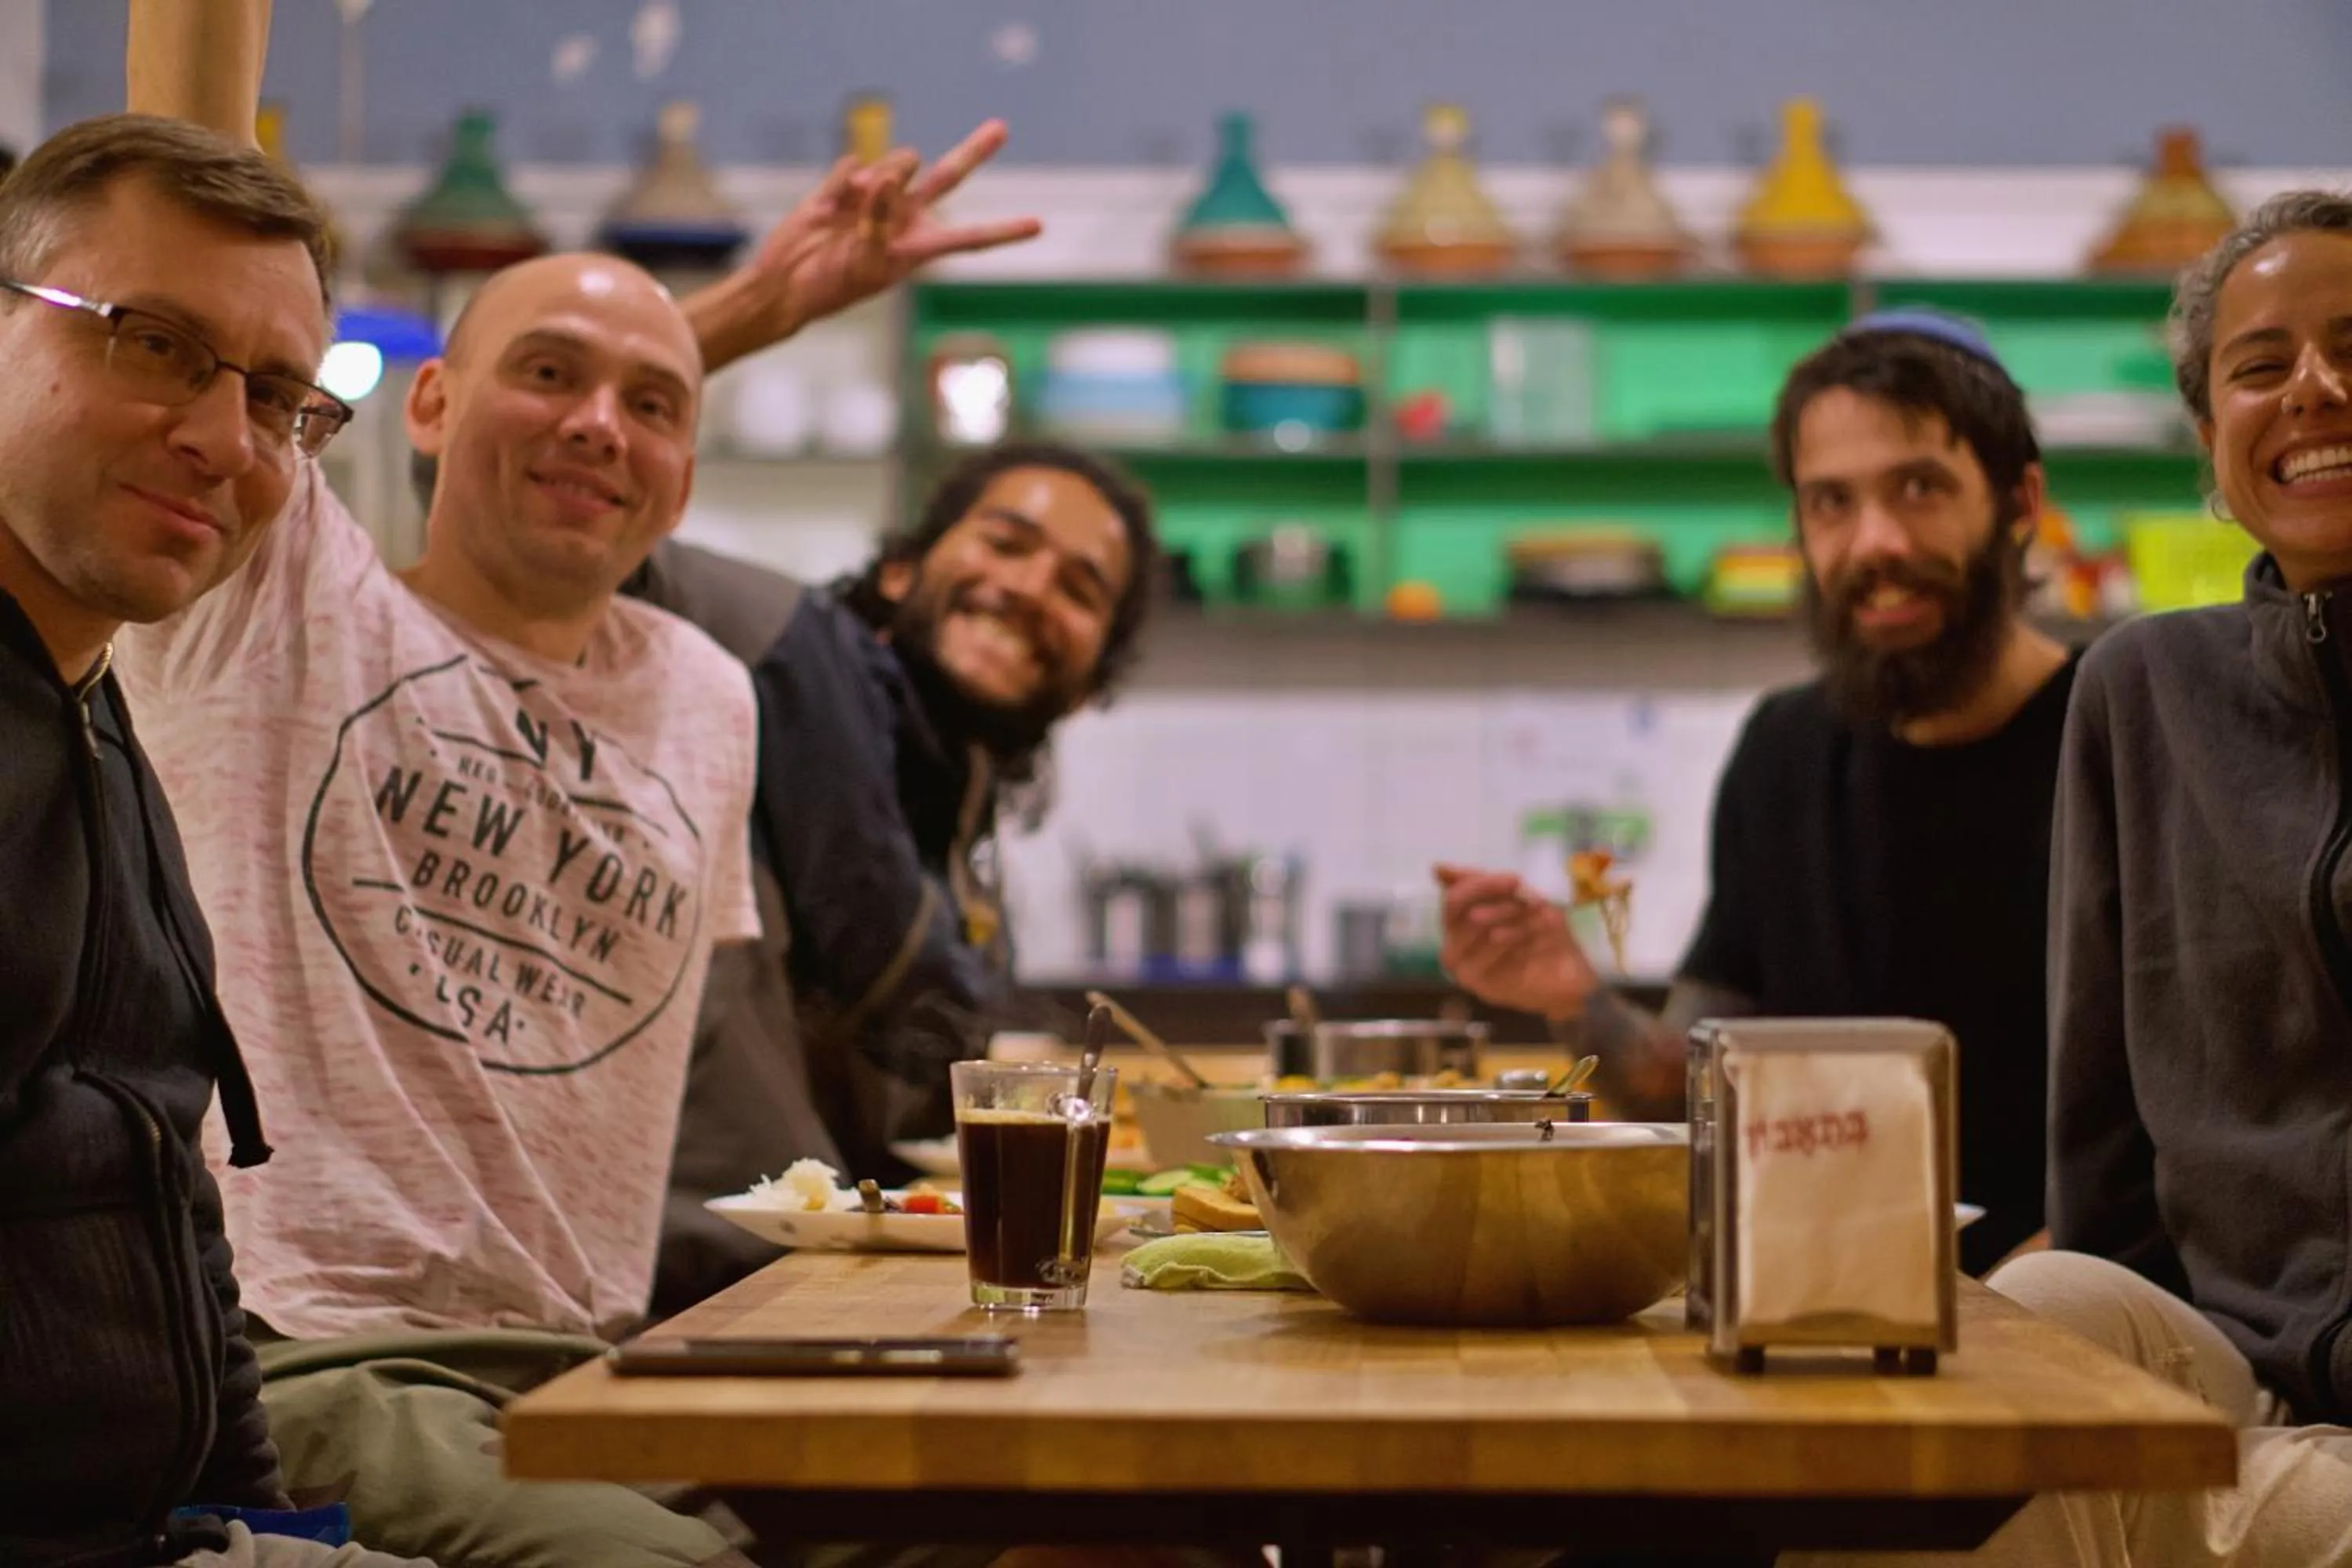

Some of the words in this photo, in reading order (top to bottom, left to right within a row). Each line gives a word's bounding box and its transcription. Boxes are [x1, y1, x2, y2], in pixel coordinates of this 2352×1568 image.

[376, 765, 524, 857] NEW
[549, 829, 687, 939] YORK
[411, 848, 621, 964] BROOKLYN
[394, 904, 500, 982] CSUAL
